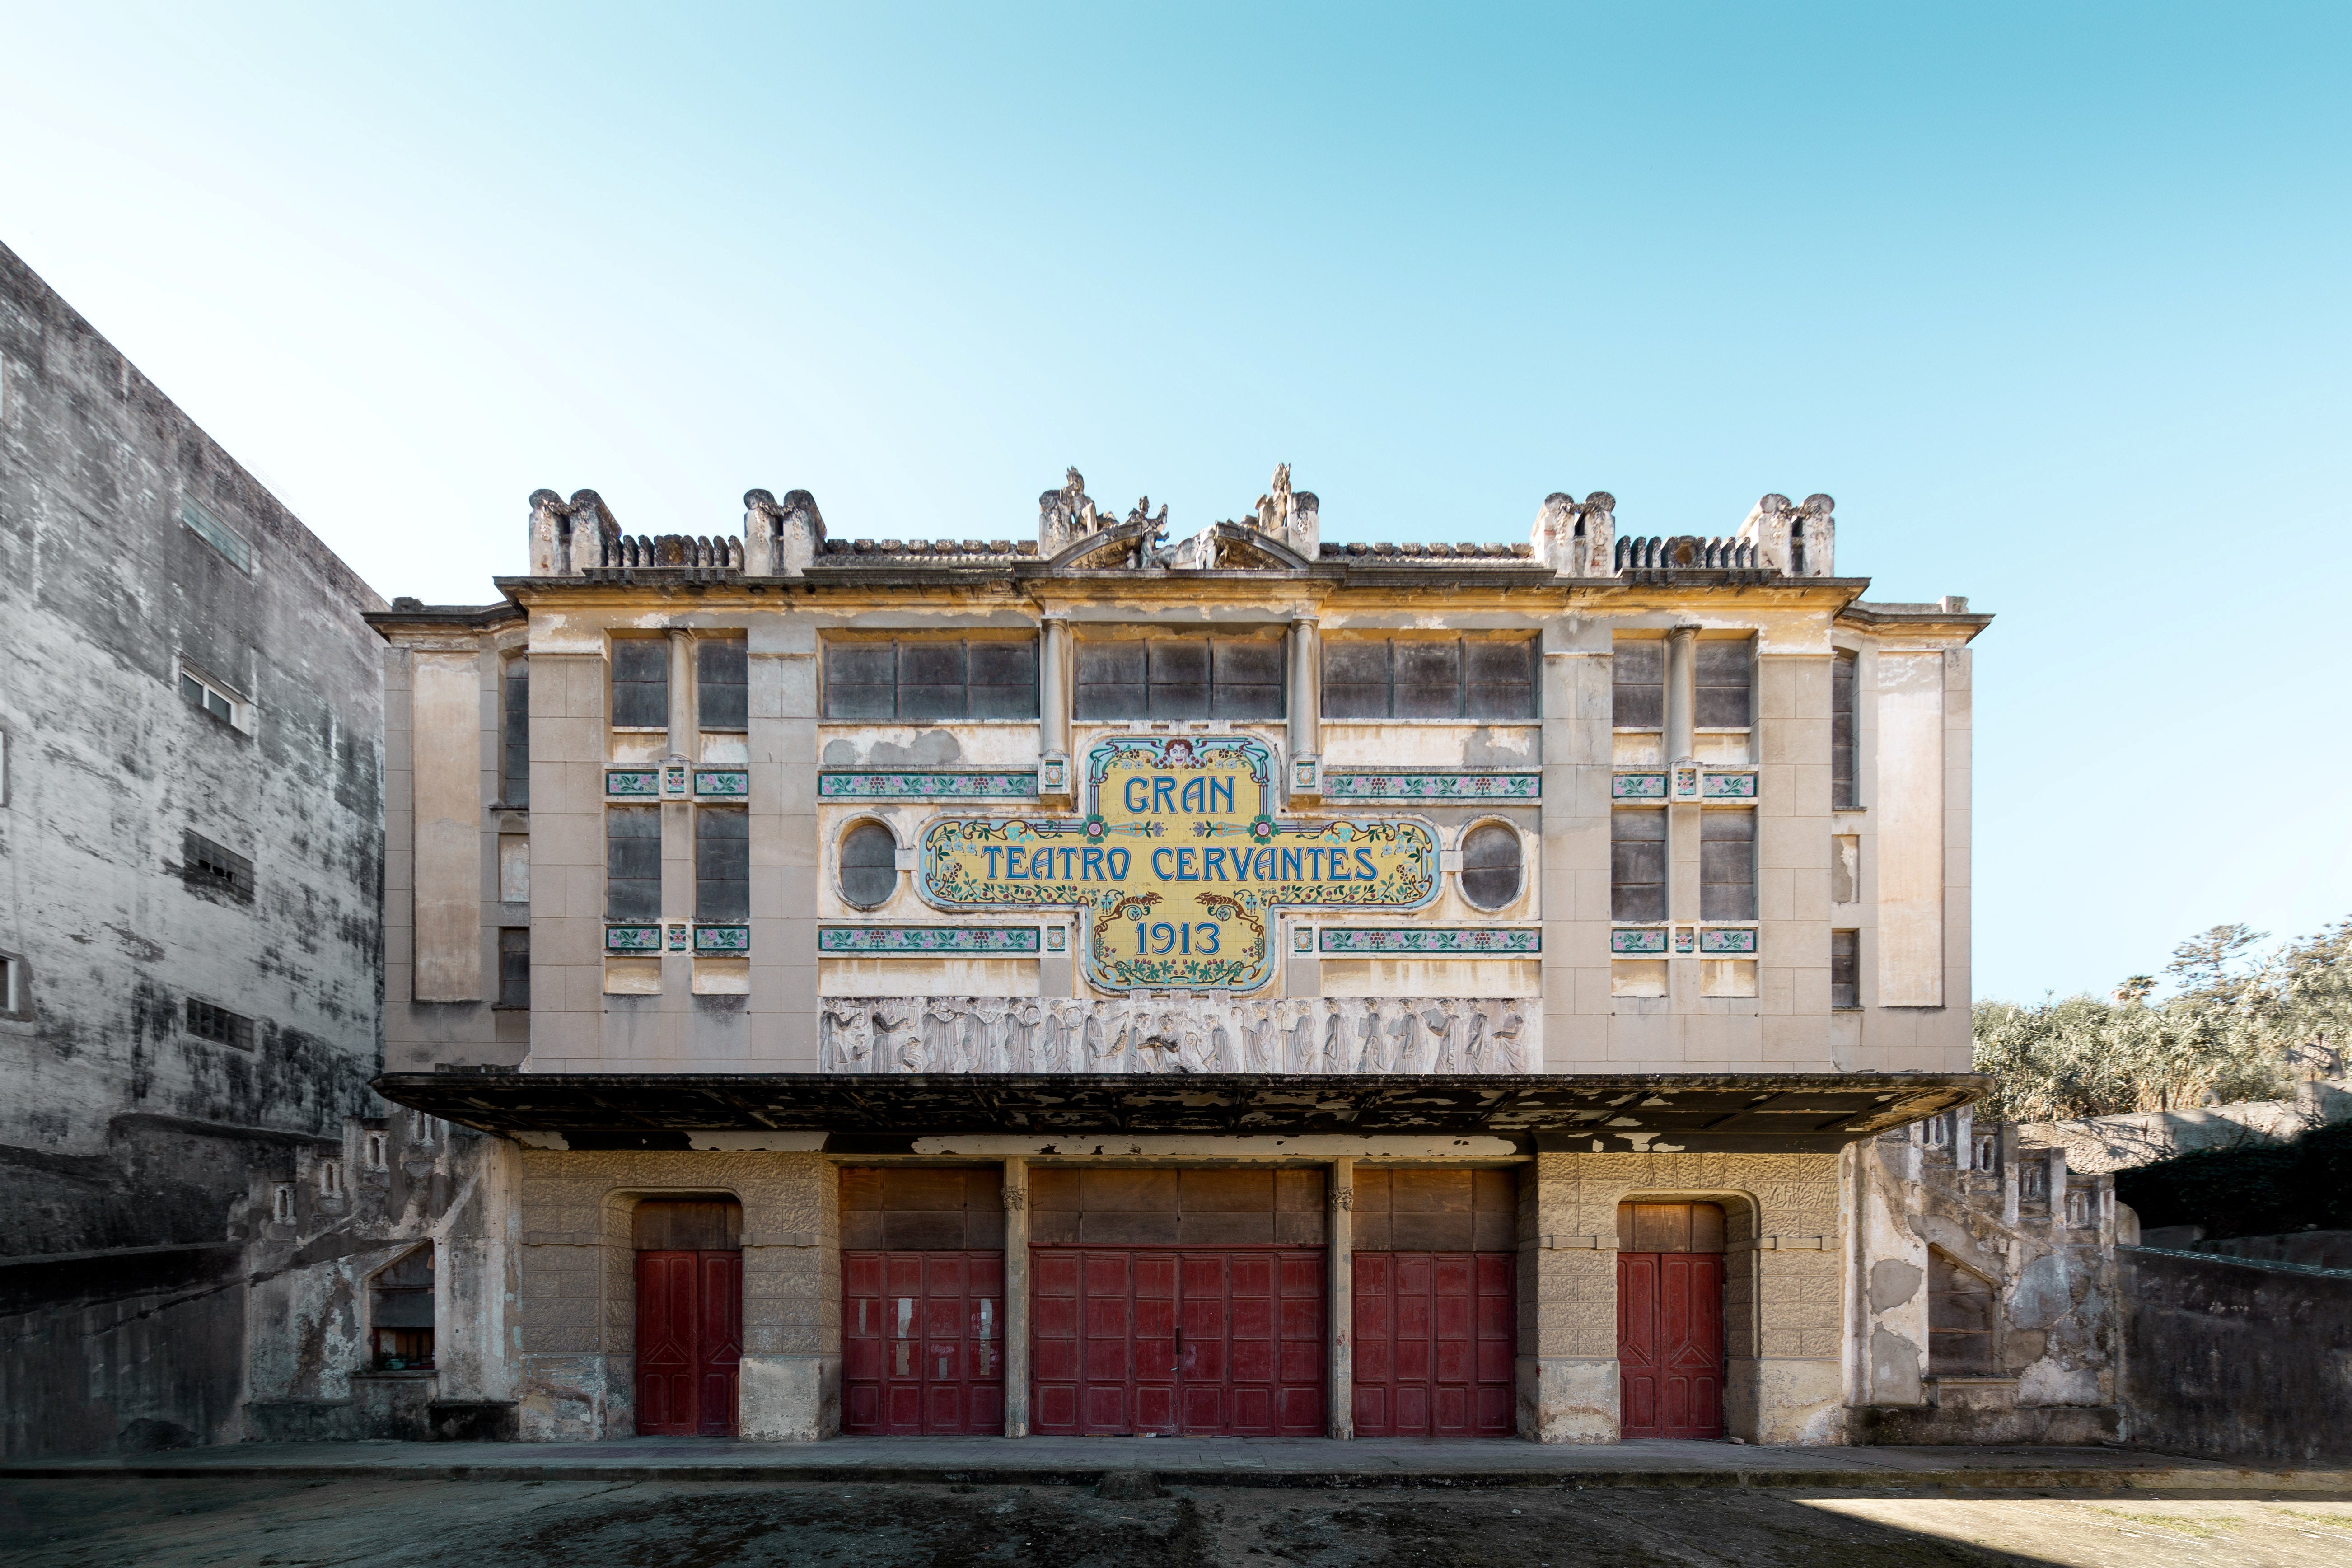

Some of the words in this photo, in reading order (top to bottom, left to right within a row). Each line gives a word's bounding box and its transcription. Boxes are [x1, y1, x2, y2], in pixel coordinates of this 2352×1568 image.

[1124, 776, 1236, 814] GRAN
[981, 845, 1131, 881] TEATRO
[1151, 846, 1378, 881] CERVANTES
[1135, 922, 1221, 955] 1913
